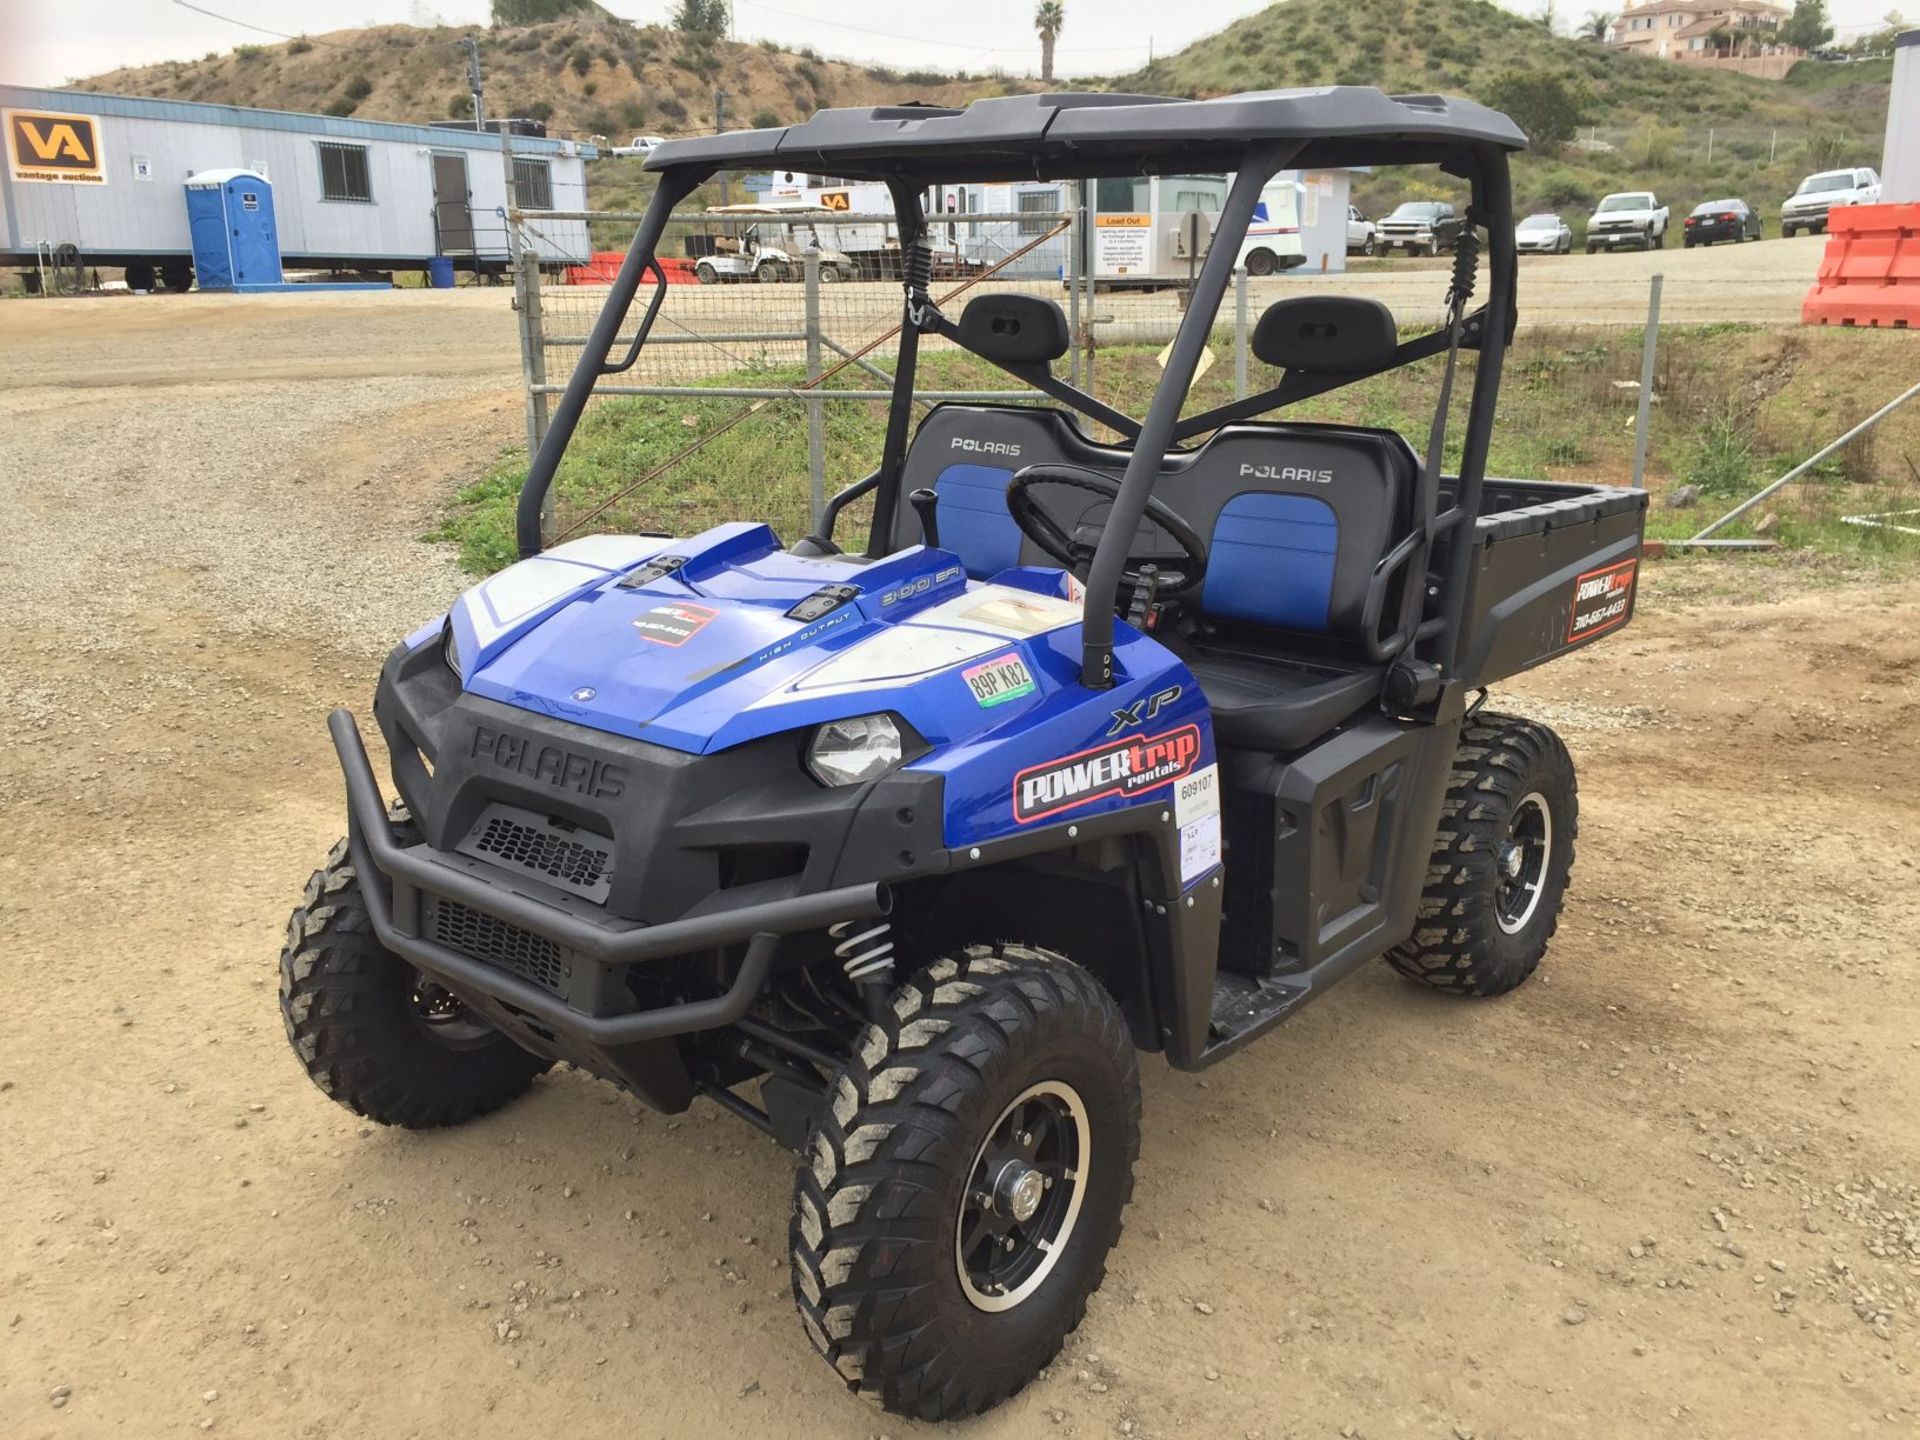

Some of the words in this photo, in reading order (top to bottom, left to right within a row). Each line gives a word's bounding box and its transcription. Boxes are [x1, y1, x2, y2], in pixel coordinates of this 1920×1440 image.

[19, 121, 91, 161] VA
[1106, 217, 1125, 225] Load
[1126, 217, 1141, 225] Out
[951, 437, 1021, 456] POLARIS
[1239, 464, 1333, 483] POLARIS
[935, 567, 959, 583] EFI
[760, 641, 792, 662] HIGH
[800, 612, 850, 640] OUTPUT
[970, 672, 998, 698] 89P
[997, 662, 1029, 688] K82
[1107, 686, 1182, 736] XP
[472, 727, 630, 798] POLARIS
[1127, 760, 1181, 788] rentals
[1181, 774, 1212, 800] 609107
